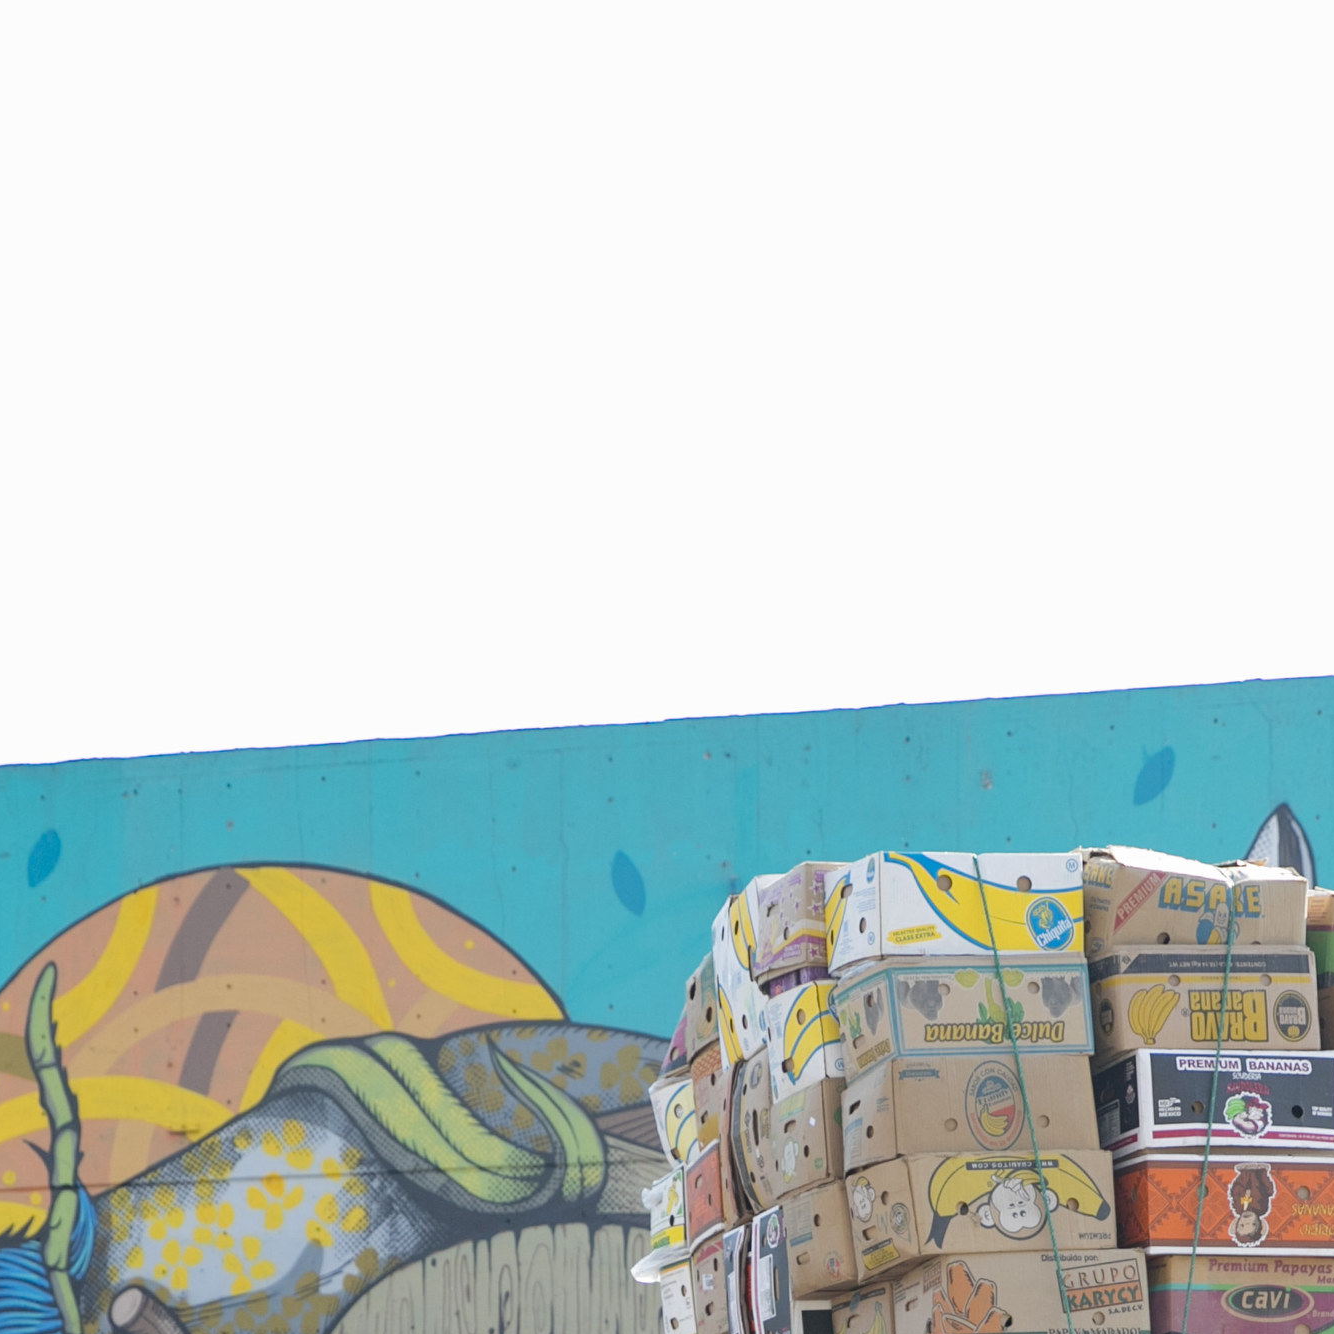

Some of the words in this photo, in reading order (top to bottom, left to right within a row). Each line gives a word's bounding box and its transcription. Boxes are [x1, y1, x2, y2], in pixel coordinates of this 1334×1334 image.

[1116, 872, 1163, 921] PREMIUM
[1035, 918, 1074, 949] Chiquita
[924, 1022, 1004, 1044] Banana
[1012, 1021, 1065, 1042] Dulce
[1177, 1058, 1240, 1071] PREMUM
[1248, 1060, 1311, 1074] BANANAS
[1083, 1254, 1099, 1264] por:
[1207, 1259, 1269, 1274] Premium
[1273, 1259, 1333, 1277] Papayas
[1061, 1263, 1137, 1289] GRUPO
[1241, 1287, 1292, 1309] cavi
[1311, 1309, 1334, 1318] Brand
